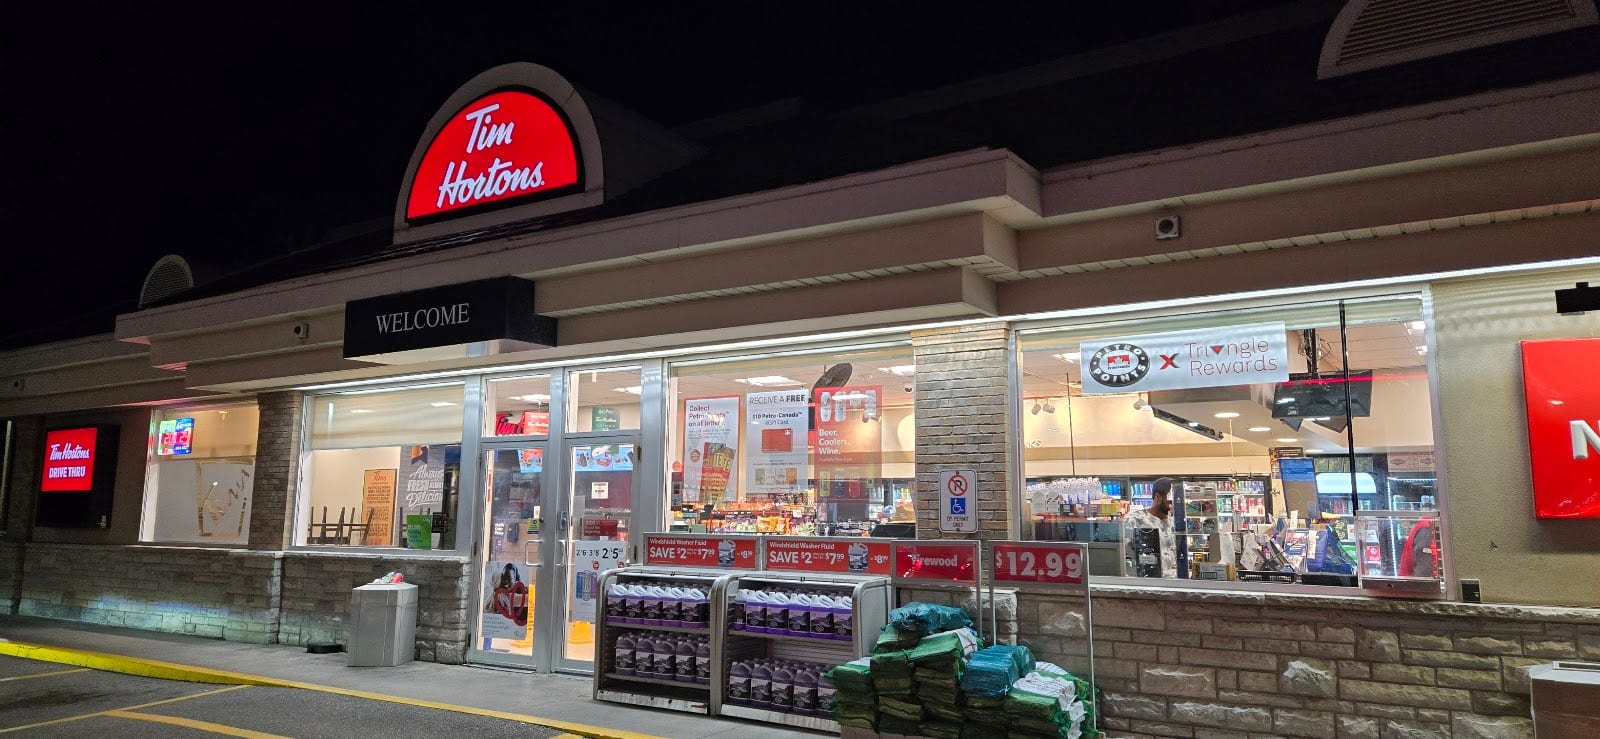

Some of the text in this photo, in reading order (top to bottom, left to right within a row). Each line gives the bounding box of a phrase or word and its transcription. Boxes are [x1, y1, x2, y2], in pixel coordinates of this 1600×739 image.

[466, 103, 514, 153] Tim
[376, 303, 470, 335] WELCOME
[1096, 344, 1142, 359] PETRO
[1190, 357, 1278, 376] Rewards
[1093, 364, 1146, 384] POINTS
[749, 395, 778, 405] RECEIVE
[786, 394, 806, 403] FREE
[818, 428, 839, 437] Beer.
[818, 438, 850, 446] Coolers.
[50, 442, 90, 460] Tim Hortons
[818, 447, 841, 455] Wine.
[48, 465, 86, 479] DRIVE THRU
[649, 537, 676, 545] Windshield
[649, 547, 675, 559] SAVE
[677, 547, 687, 559] $2
[769, 551, 799, 564] SAVE
[801, 551, 812, 564] $2
[995, 550, 1082, 578] $12.99
